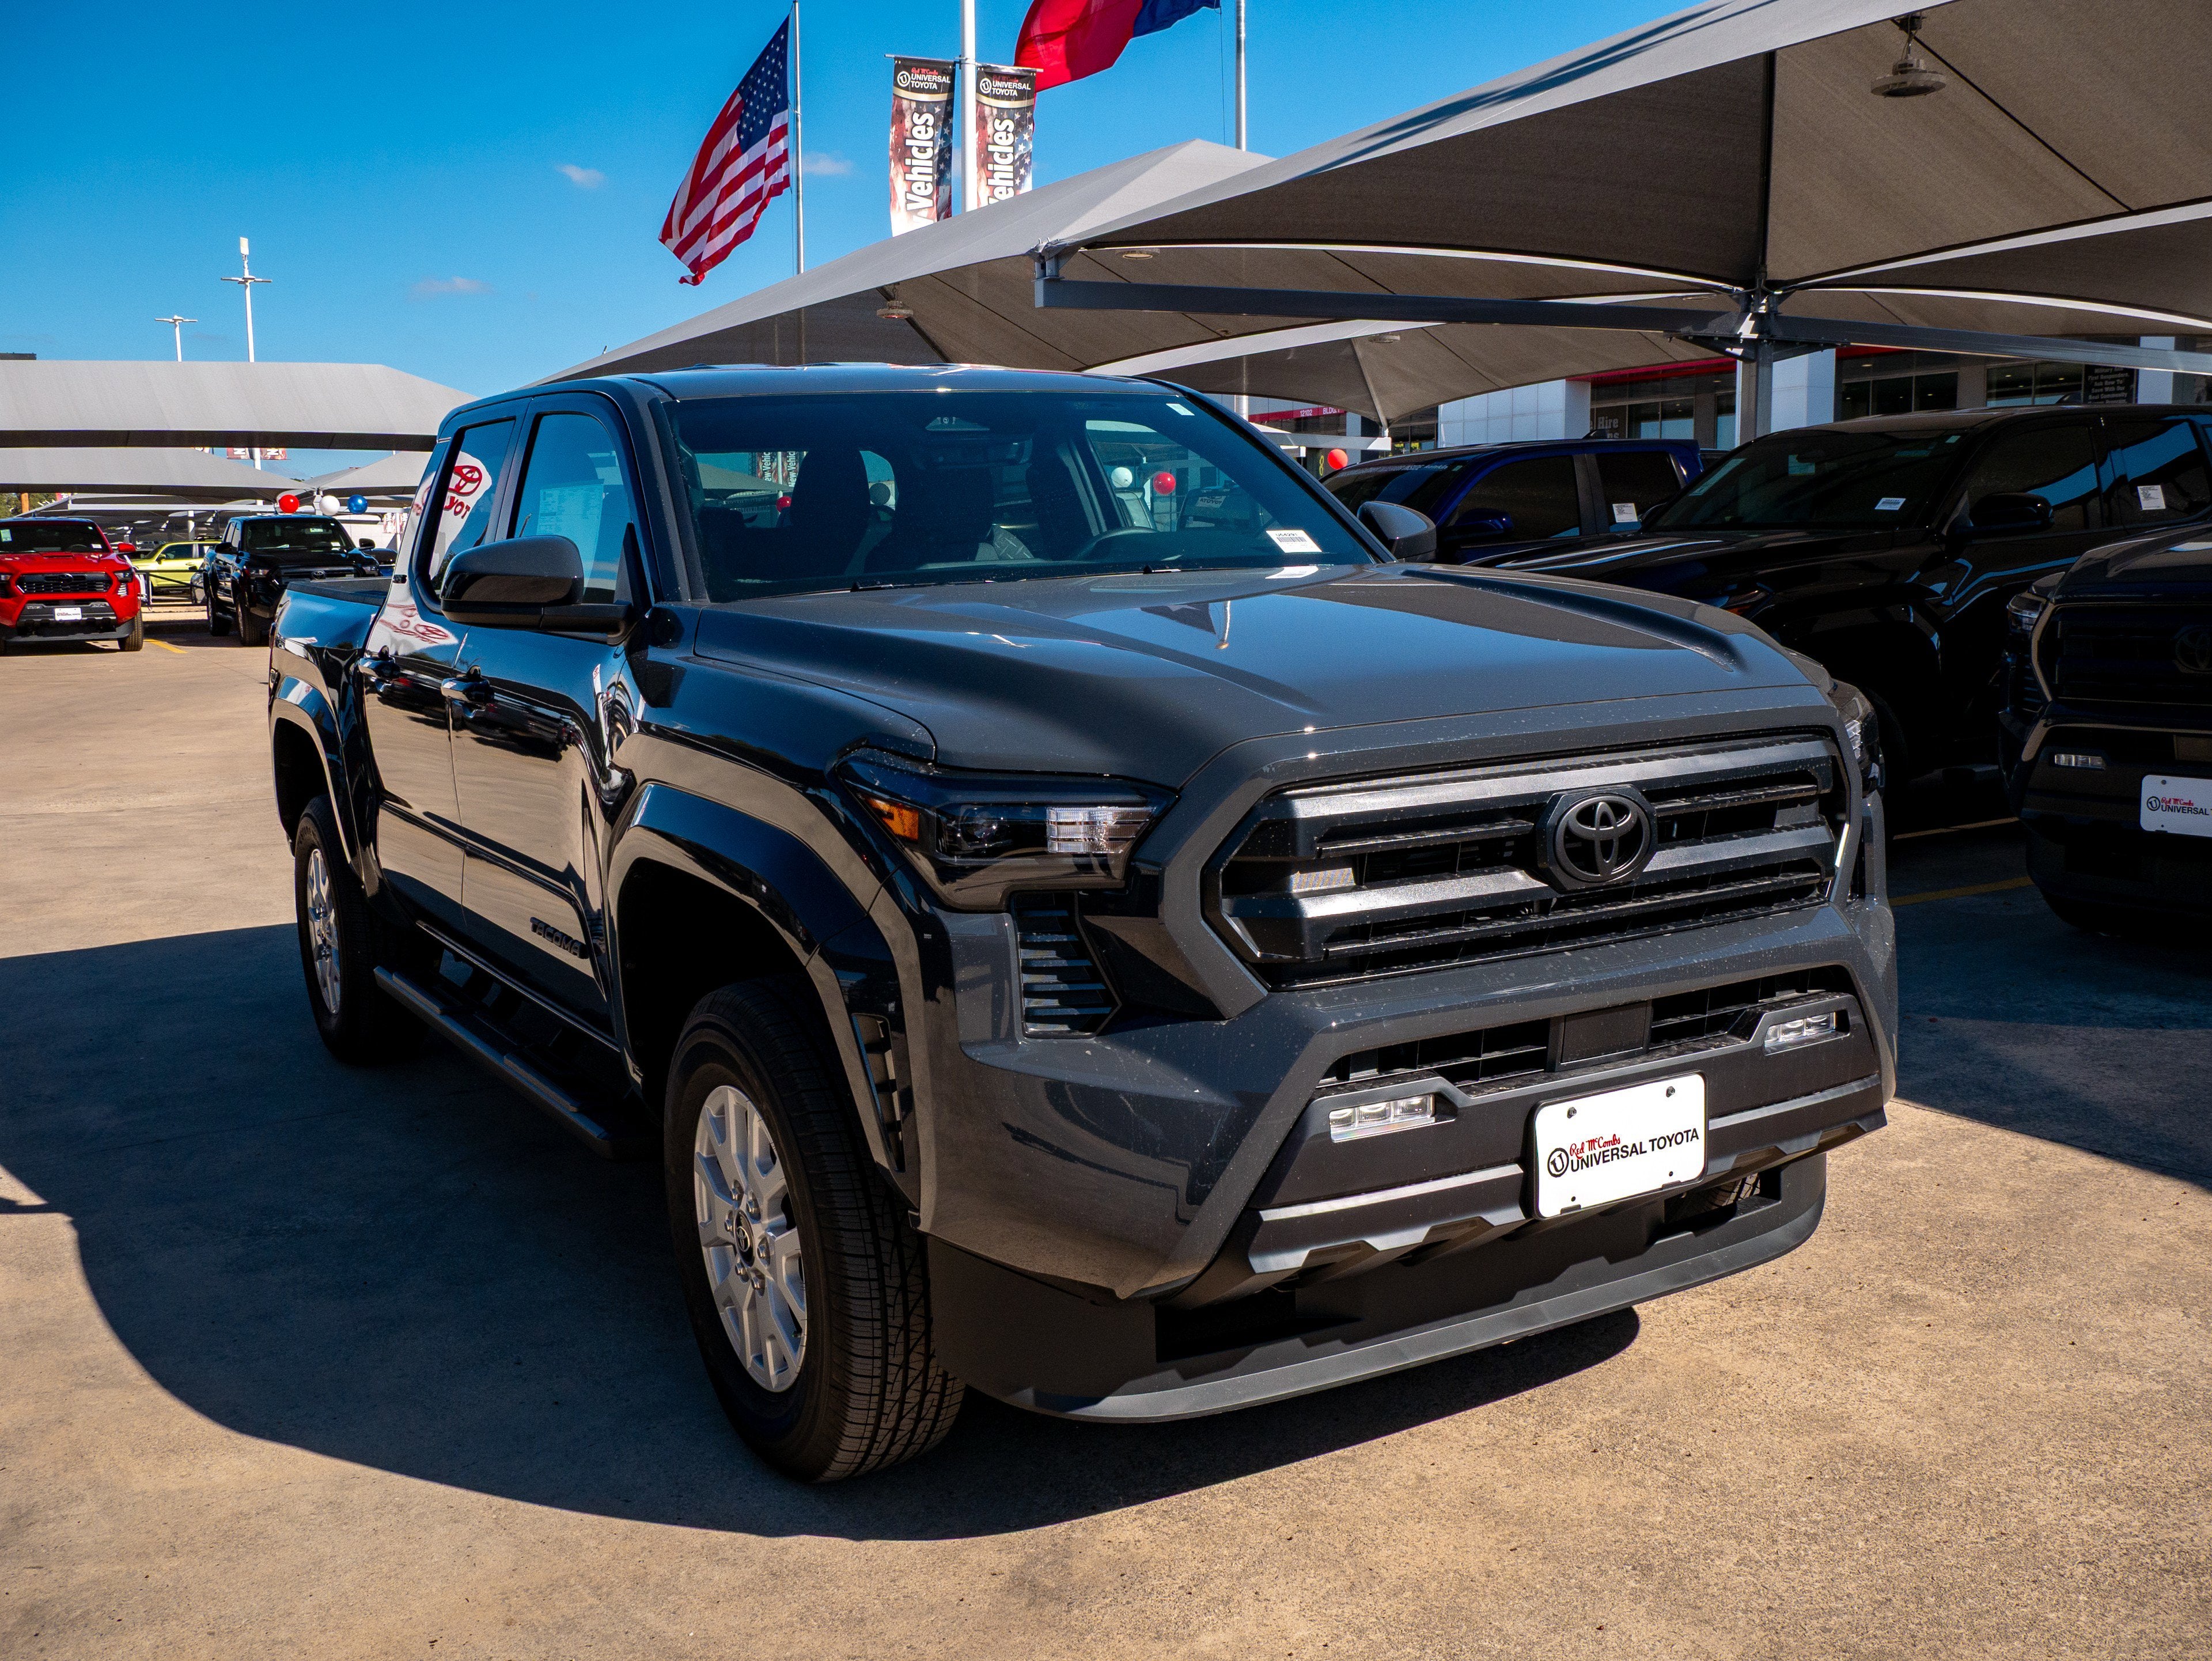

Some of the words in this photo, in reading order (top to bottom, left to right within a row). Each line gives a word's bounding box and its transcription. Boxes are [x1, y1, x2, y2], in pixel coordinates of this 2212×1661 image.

[911, 73, 951, 83] UNIVERSAL
[911, 81, 938, 90] TOYOTA
[993, 80, 1031, 90] UNIVERSAL
[991, 88, 1018, 97] TOYOTA
[905, 111, 935, 211] Vehicles
[987, 118, 1015, 205] ehicles
[1319, 455, 1324, 476] 8
[2161, 805, 2210, 816] UNIVERSAL
[530, 917, 585, 959] TACOMA
[1569, 1141, 1585, 1160] Red
[1586, 1134, 1621, 1152] McCombs
[1571, 1141, 1647, 1172] UNIVERSAL
[1649, 1127, 1699, 1152] TOYOTA
